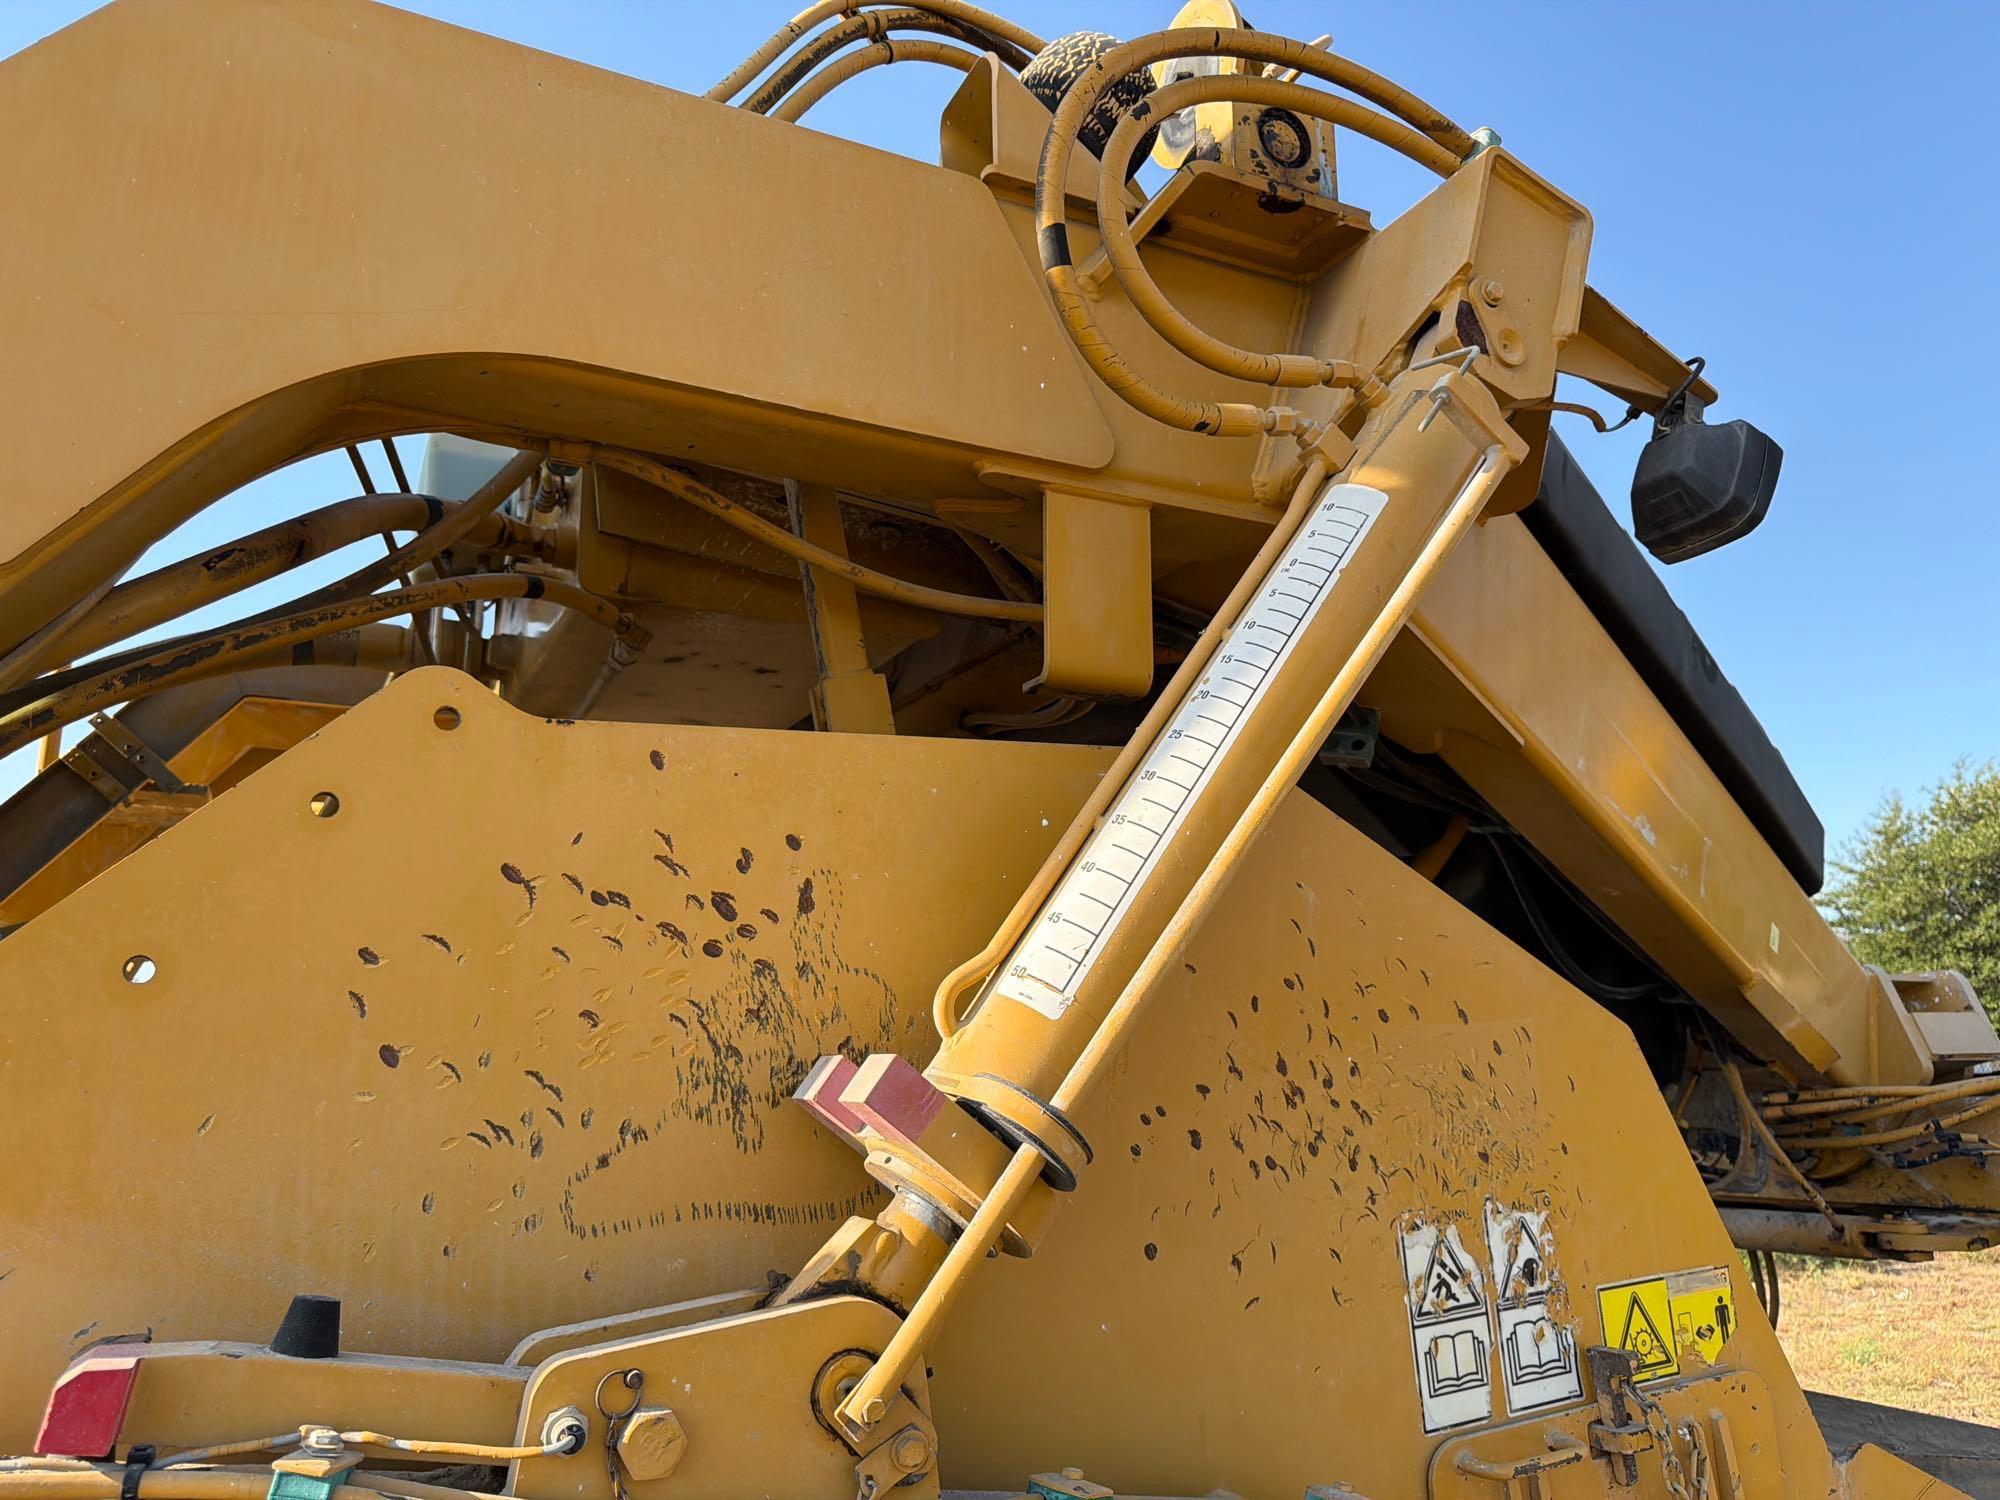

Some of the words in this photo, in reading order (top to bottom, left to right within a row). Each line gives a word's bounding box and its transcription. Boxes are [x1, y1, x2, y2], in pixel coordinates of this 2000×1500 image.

[1322, 503, 1335, 511] 10
[1308, 530, 1316, 538] 5
[1289, 559, 1298, 567] 0
[1269, 589, 1277, 597] 5
[1243, 621, 1255, 629] 10
[1220, 655, 1232, 664] 15
[1197, 690, 1210, 700] 20
[1168, 729, 1183, 739] 25
[1141, 770, 1155, 781] 30
[1112, 815, 1126, 825] 35
[1081, 861, 1096, 873] 40
[1047, 911, 1063, 924] 45
[1011, 965, 1026, 979] 50
